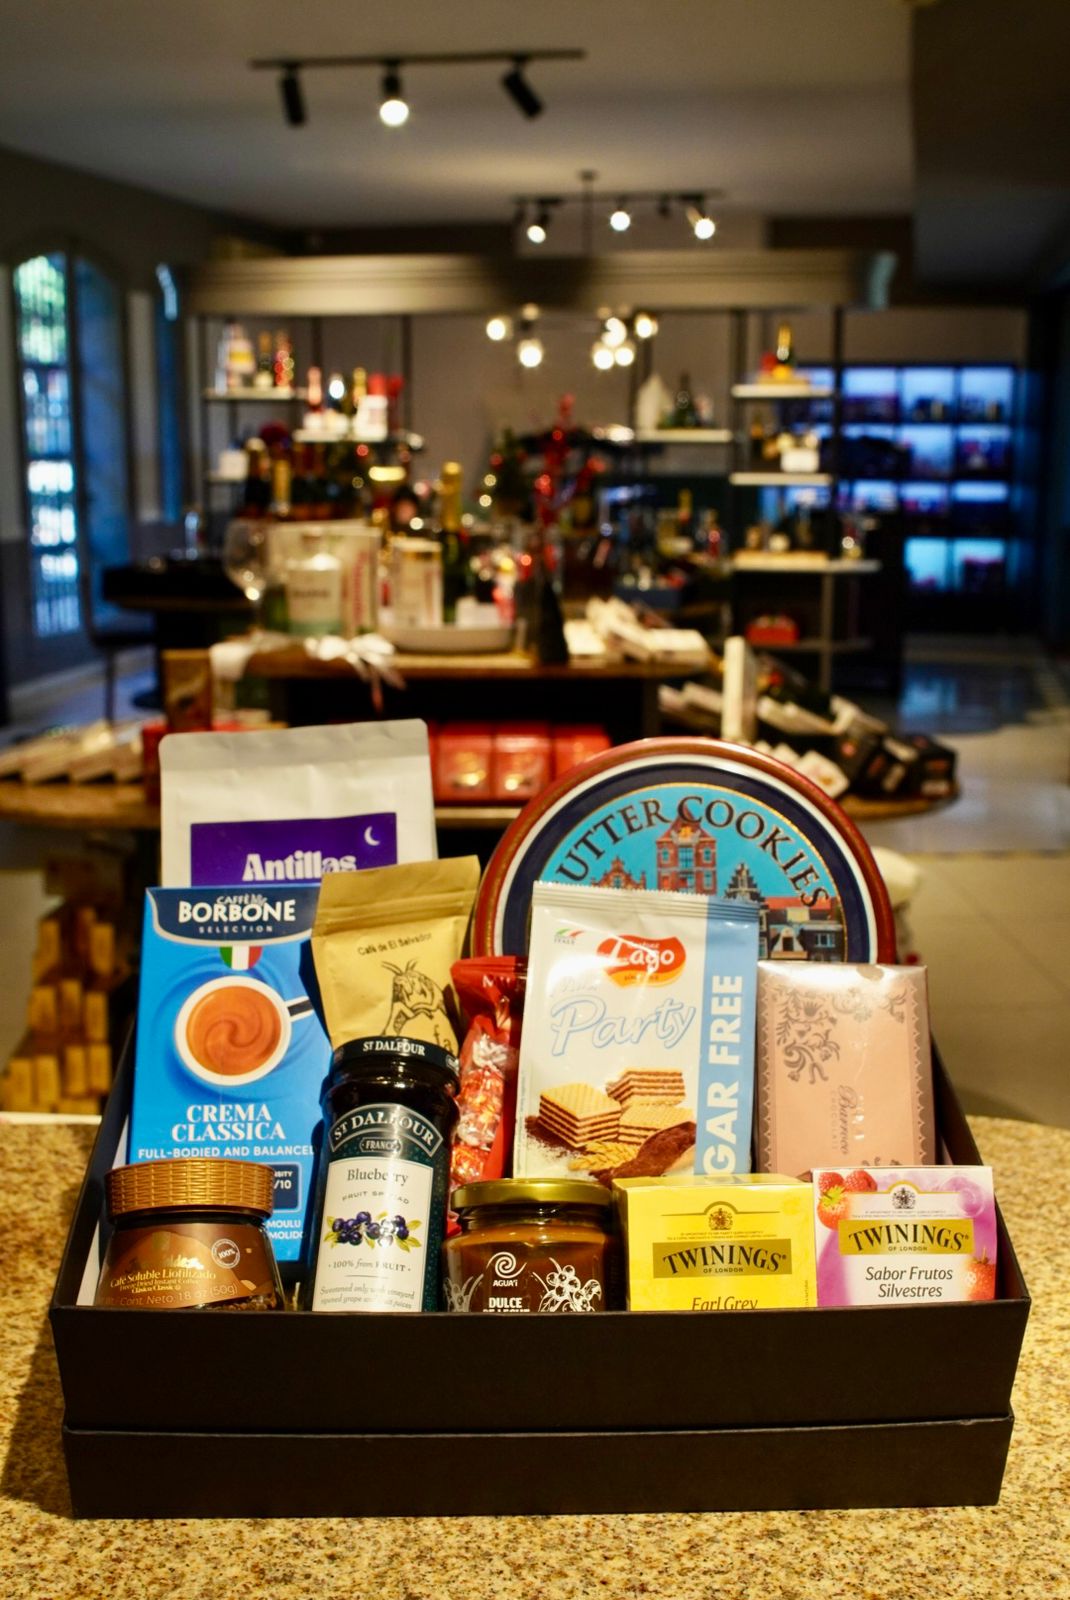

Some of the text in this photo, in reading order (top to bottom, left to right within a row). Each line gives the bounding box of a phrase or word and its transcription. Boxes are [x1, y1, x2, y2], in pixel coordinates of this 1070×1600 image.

[677, 796, 830, 908] COOKIES
[242, 850, 357, 881] Antillas
[178, 899, 296, 923] BORBONE
[199, 924, 274, 934] SELECTION
[609, 938, 675, 974] Lago
[551, 993, 697, 1057] Party
[707, 974, 743, 1066] FREE
[375, 1040, 426, 1056] DALFOUR
[187, 1104, 272, 1122] CREMA
[171, 1122, 286, 1142] CLASSICA
[351, 1111, 434, 1146] DALFOUR
[138, 1147, 220, 1159] FULL-BODIED
[223, 1147, 250, 1156] AND
[347, 1168, 408, 1187] Bluebery
[372, 1191, 410, 1204] SPAD
[848, 1223, 965, 1252] TWININGS
[663, 1244, 783, 1274] TWININGS
[865, 1266, 953, 1281] Sabor Frutos
[878, 1283, 943, 1298] Silvestres
[489, 1297, 522, 1309] DULCE
[691, 1296, 758, 1310] Earl Grey
